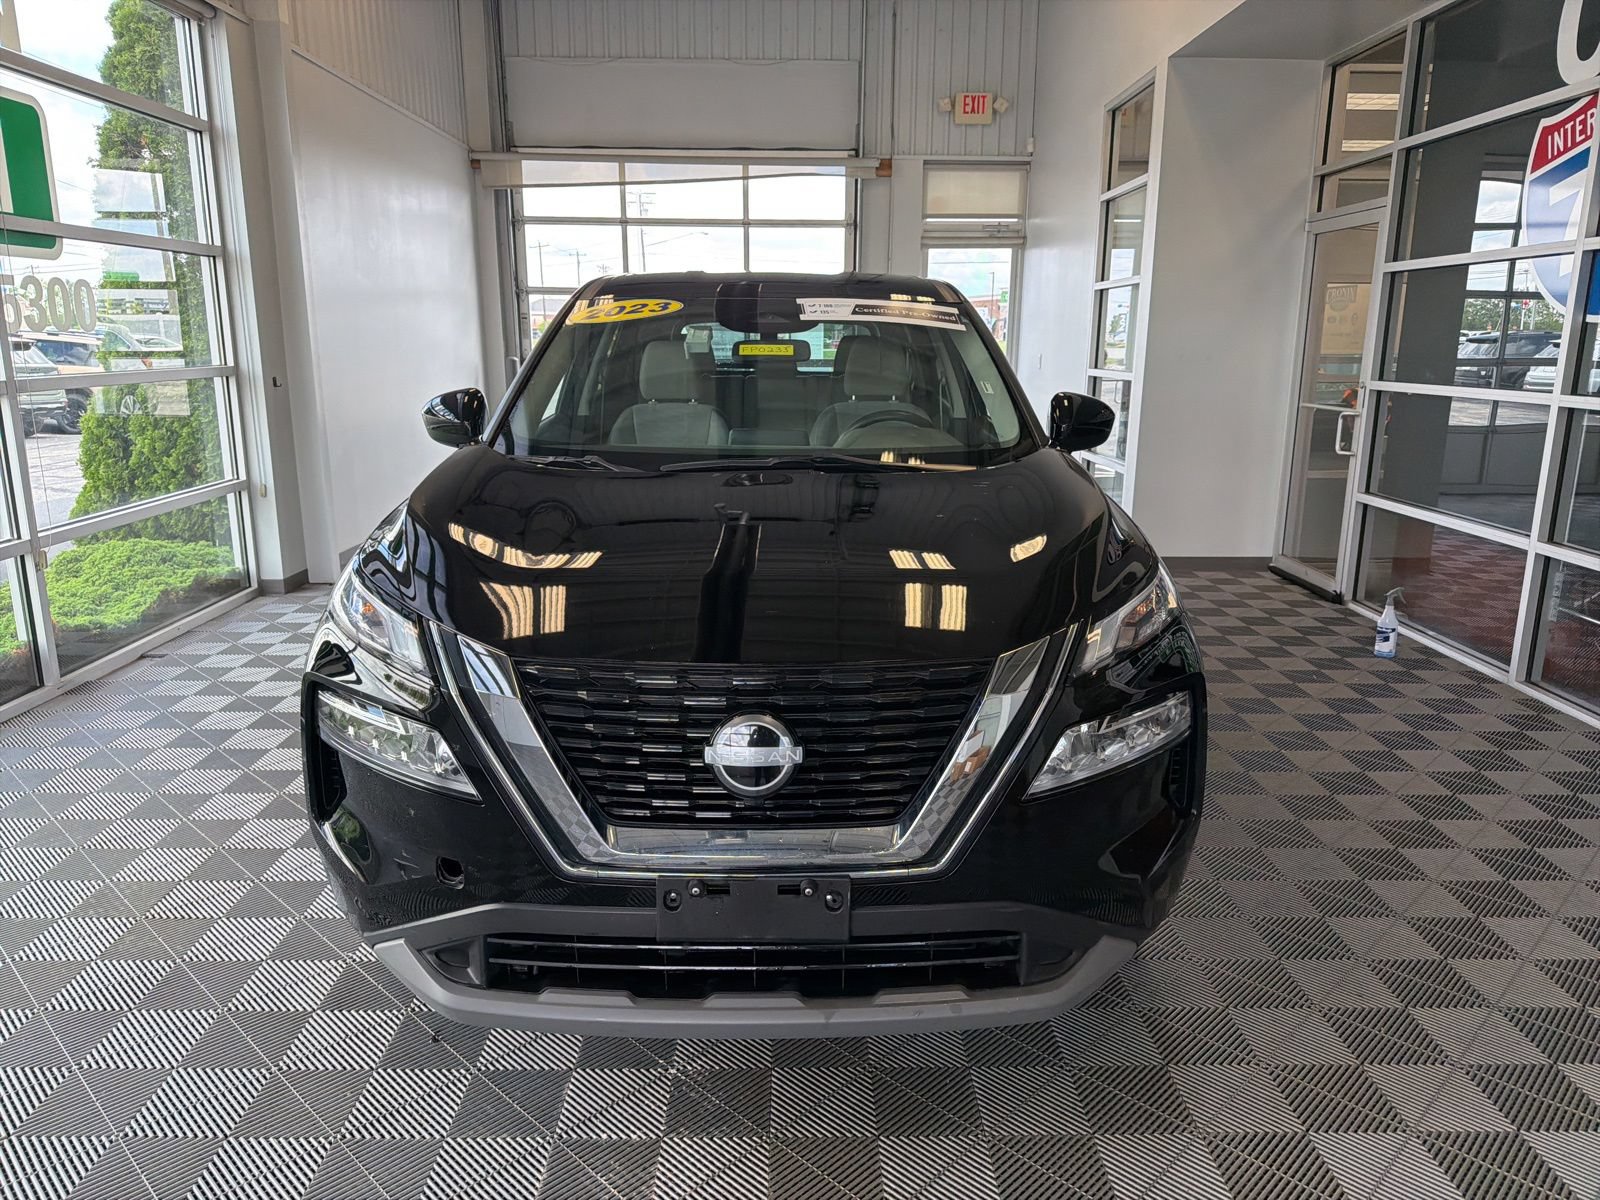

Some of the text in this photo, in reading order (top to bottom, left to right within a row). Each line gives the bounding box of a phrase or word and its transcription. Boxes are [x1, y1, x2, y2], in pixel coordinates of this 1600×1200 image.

[963, 95, 988, 114] EXIT
[580, 302, 673, 320] 2023
[855, 306, 899, 315] Certified
[901, 308, 956, 321] Pre-Owned
[707, 749, 801, 764] NISSAN
